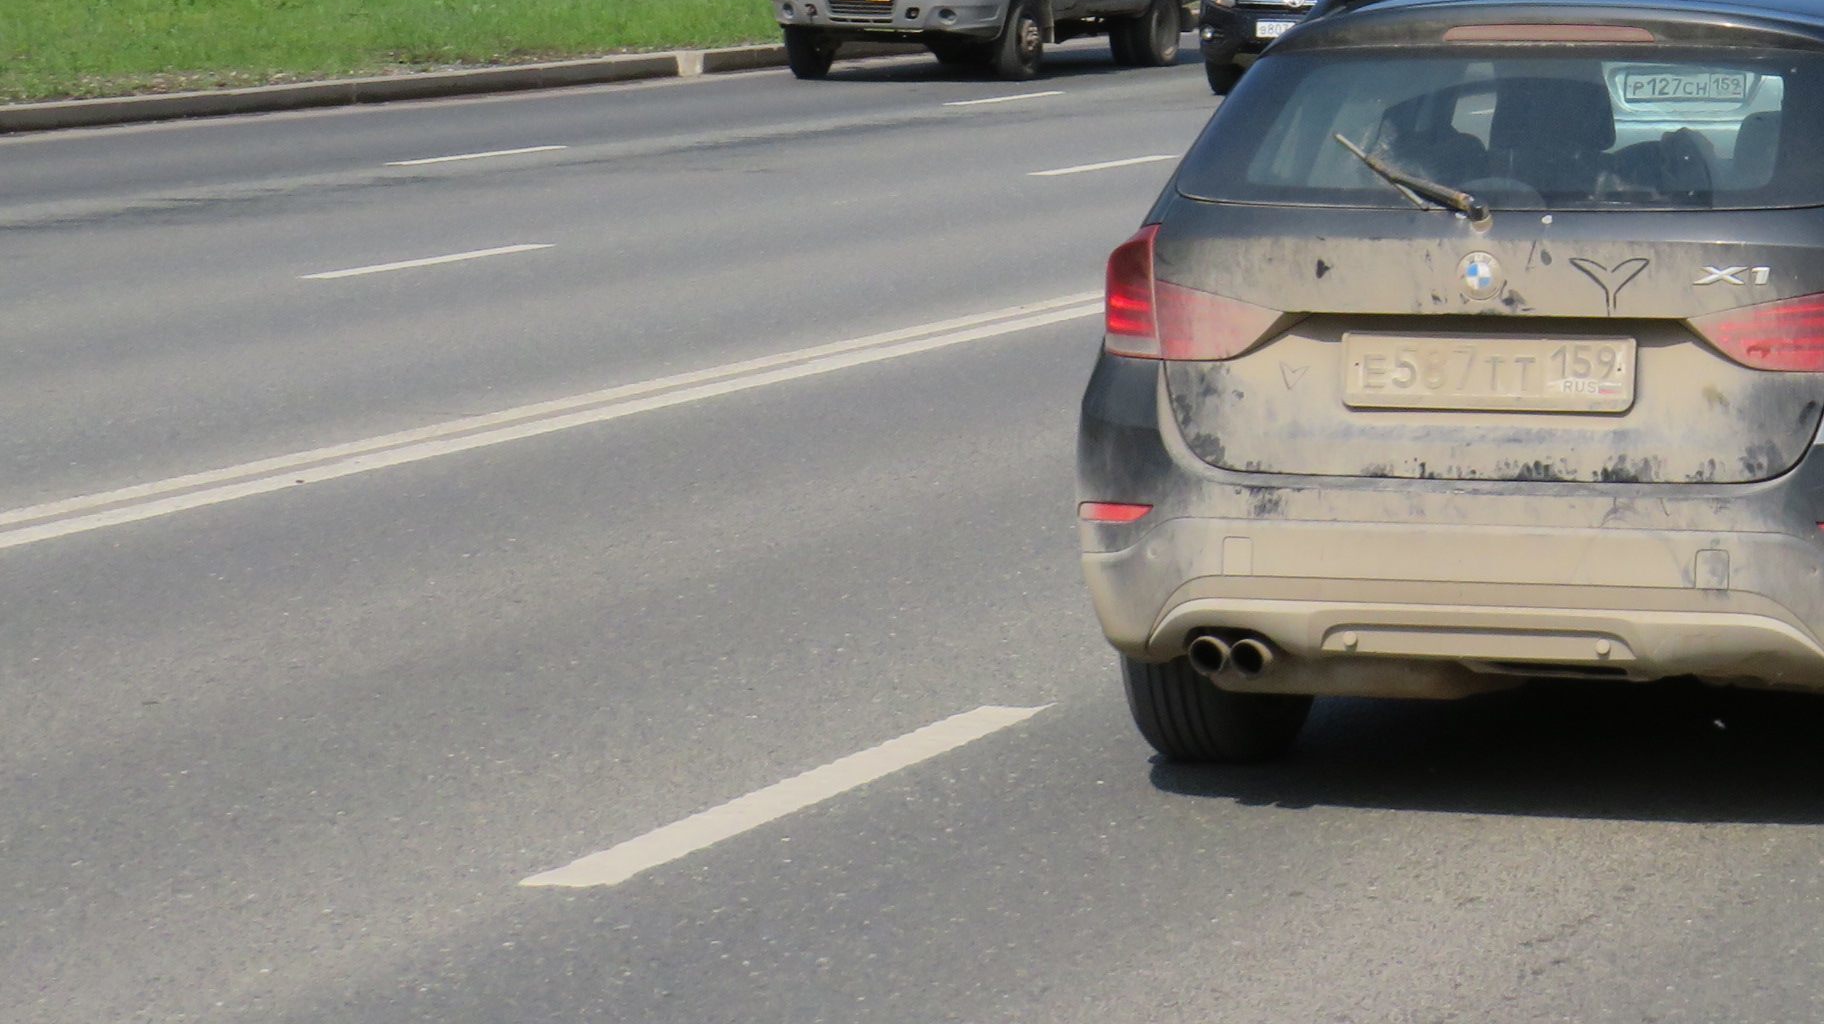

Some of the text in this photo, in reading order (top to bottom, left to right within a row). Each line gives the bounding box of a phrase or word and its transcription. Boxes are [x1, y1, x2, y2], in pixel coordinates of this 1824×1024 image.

[1632, 78, 1742, 96] Р127СН 159
[1692, 265, 1770, 286] X1
[1550, 344, 1618, 380] 159
[1562, 380, 1597, 394] RUS
